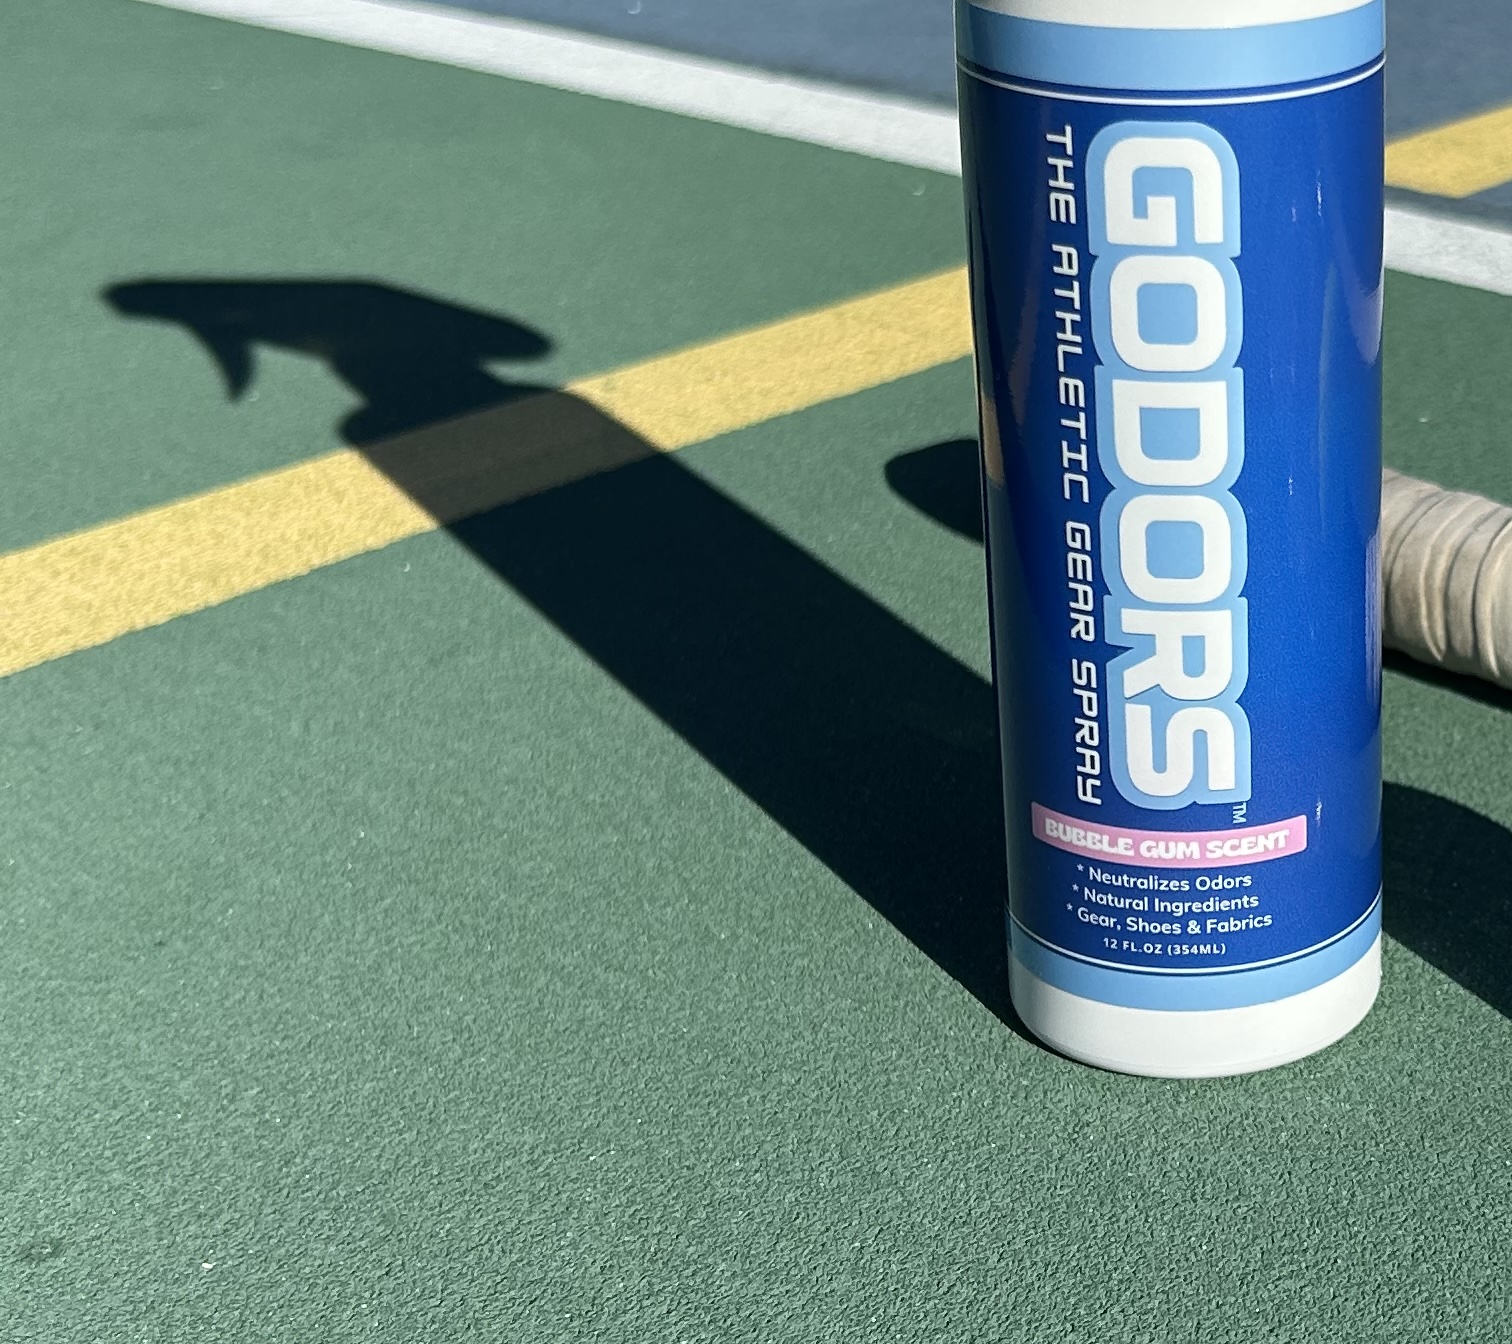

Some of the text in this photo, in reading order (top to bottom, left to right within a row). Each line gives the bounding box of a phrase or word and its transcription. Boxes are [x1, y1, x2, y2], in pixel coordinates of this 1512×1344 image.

[1045, 123, 1103, 806] THE ATHLETIC GEAR SPRAY
[1094, 128, 1244, 805] GODORS
[1043, 817, 1291, 860] BUBBLE GUM SCENT
[1088, 865, 1253, 892] Neutralizes Odors
[1083, 885, 1260, 917] Natural Ingredients
[1076, 907, 1273, 936] Gear, Shoes & Fabrics
[1102, 936, 1119, 950] 12
[1166, 942, 1227, 957] (354ML)
